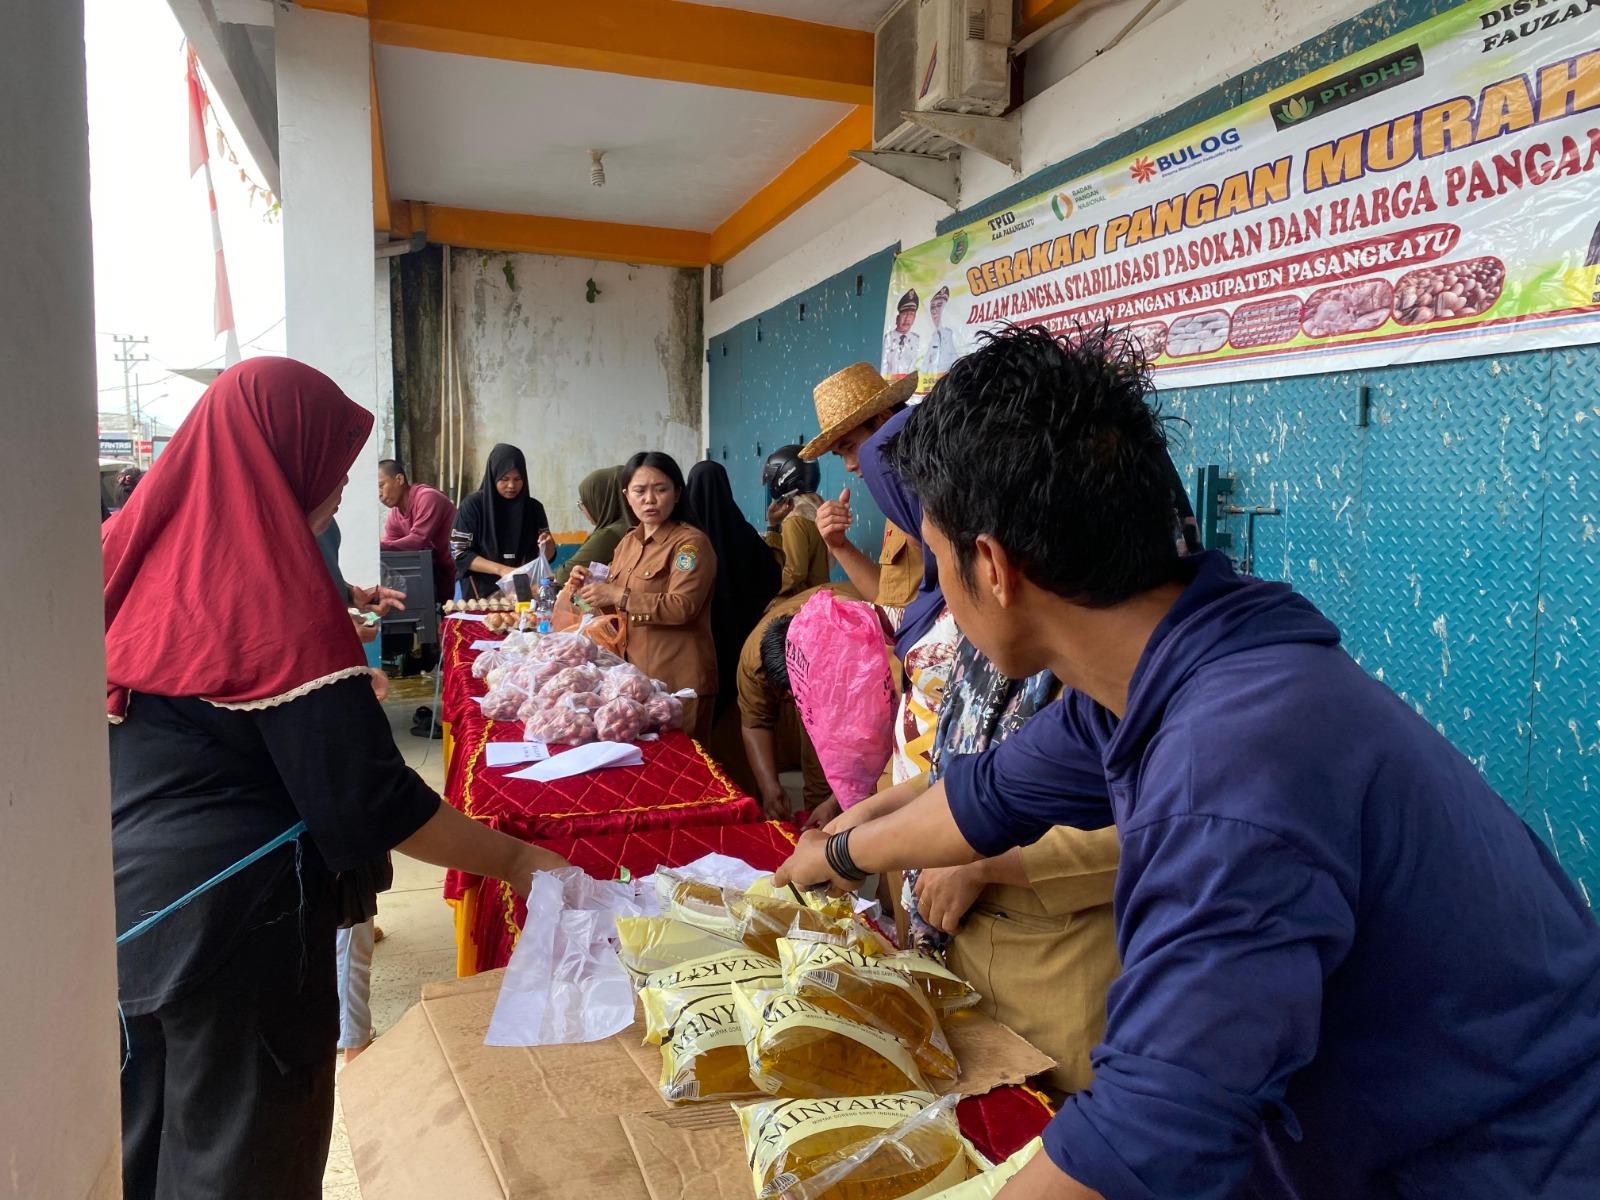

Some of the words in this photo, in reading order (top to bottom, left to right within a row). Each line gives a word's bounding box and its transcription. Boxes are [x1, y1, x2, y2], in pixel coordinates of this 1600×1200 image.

[1319, 86, 1355, 104] PT.
[1360, 56, 1418, 88] DHS
[966, 226, 1099, 296] GERAKAN
[1104, 155, 1293, 255] PANGAN
[1303, 48, 1600, 194] MURAH
[1157, 128, 1240, 171] BULOG
[1075, 190, 1099, 203] PANGAN
[988, 211, 1016, 231] TPID
[966, 295, 1012, 324] DALAM
[1011, 280, 1065, 315] RANGKA
[1064, 251, 1160, 301] STABILISASI
[1164, 222, 1262, 276] PASOKAN
[1268, 205, 1322, 250] DAN
[1329, 176, 1438, 236] HARGA
[1117, 290, 1179, 319] PANGAN
[1178, 267, 1284, 305] KABUPATEN
[1288, 228, 1455, 283] PASANGKAYU
